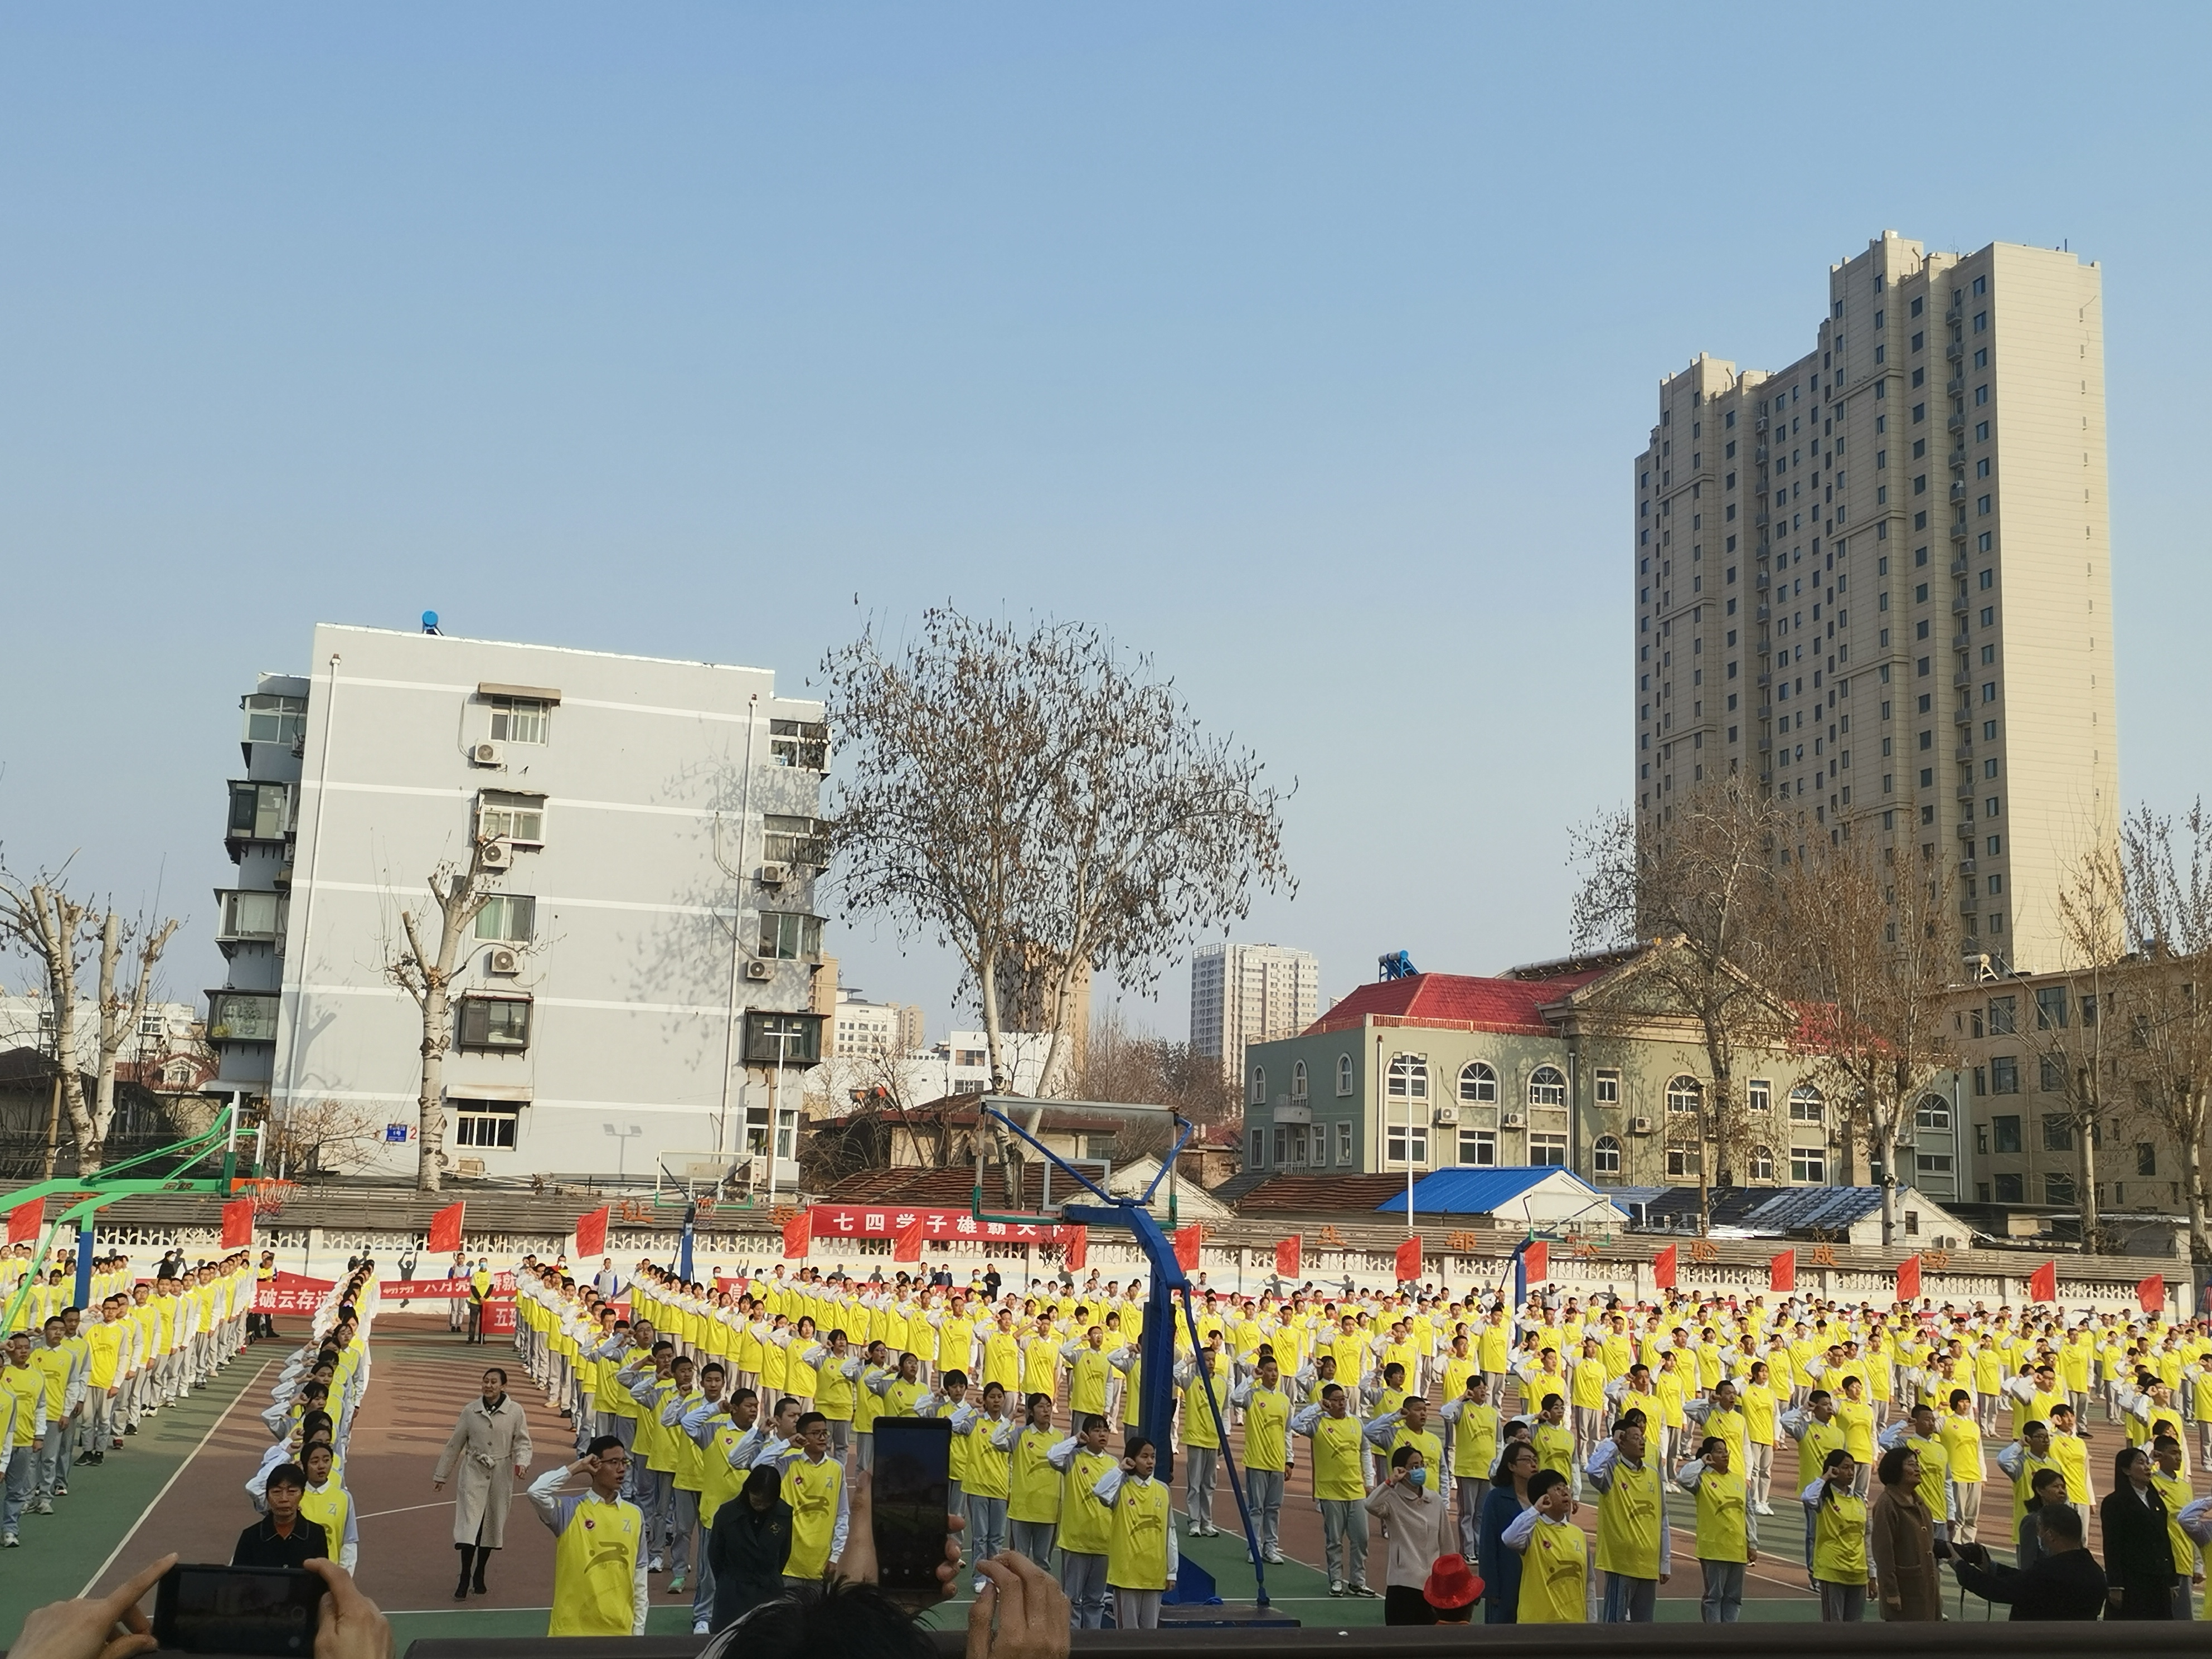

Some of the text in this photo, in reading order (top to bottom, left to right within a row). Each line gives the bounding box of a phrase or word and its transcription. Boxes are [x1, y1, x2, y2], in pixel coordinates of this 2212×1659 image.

[1316, 1225, 1347, 1246] 生
[1445, 1230, 1477, 1253] 都
[1810, 1245, 1840, 1267] 成
